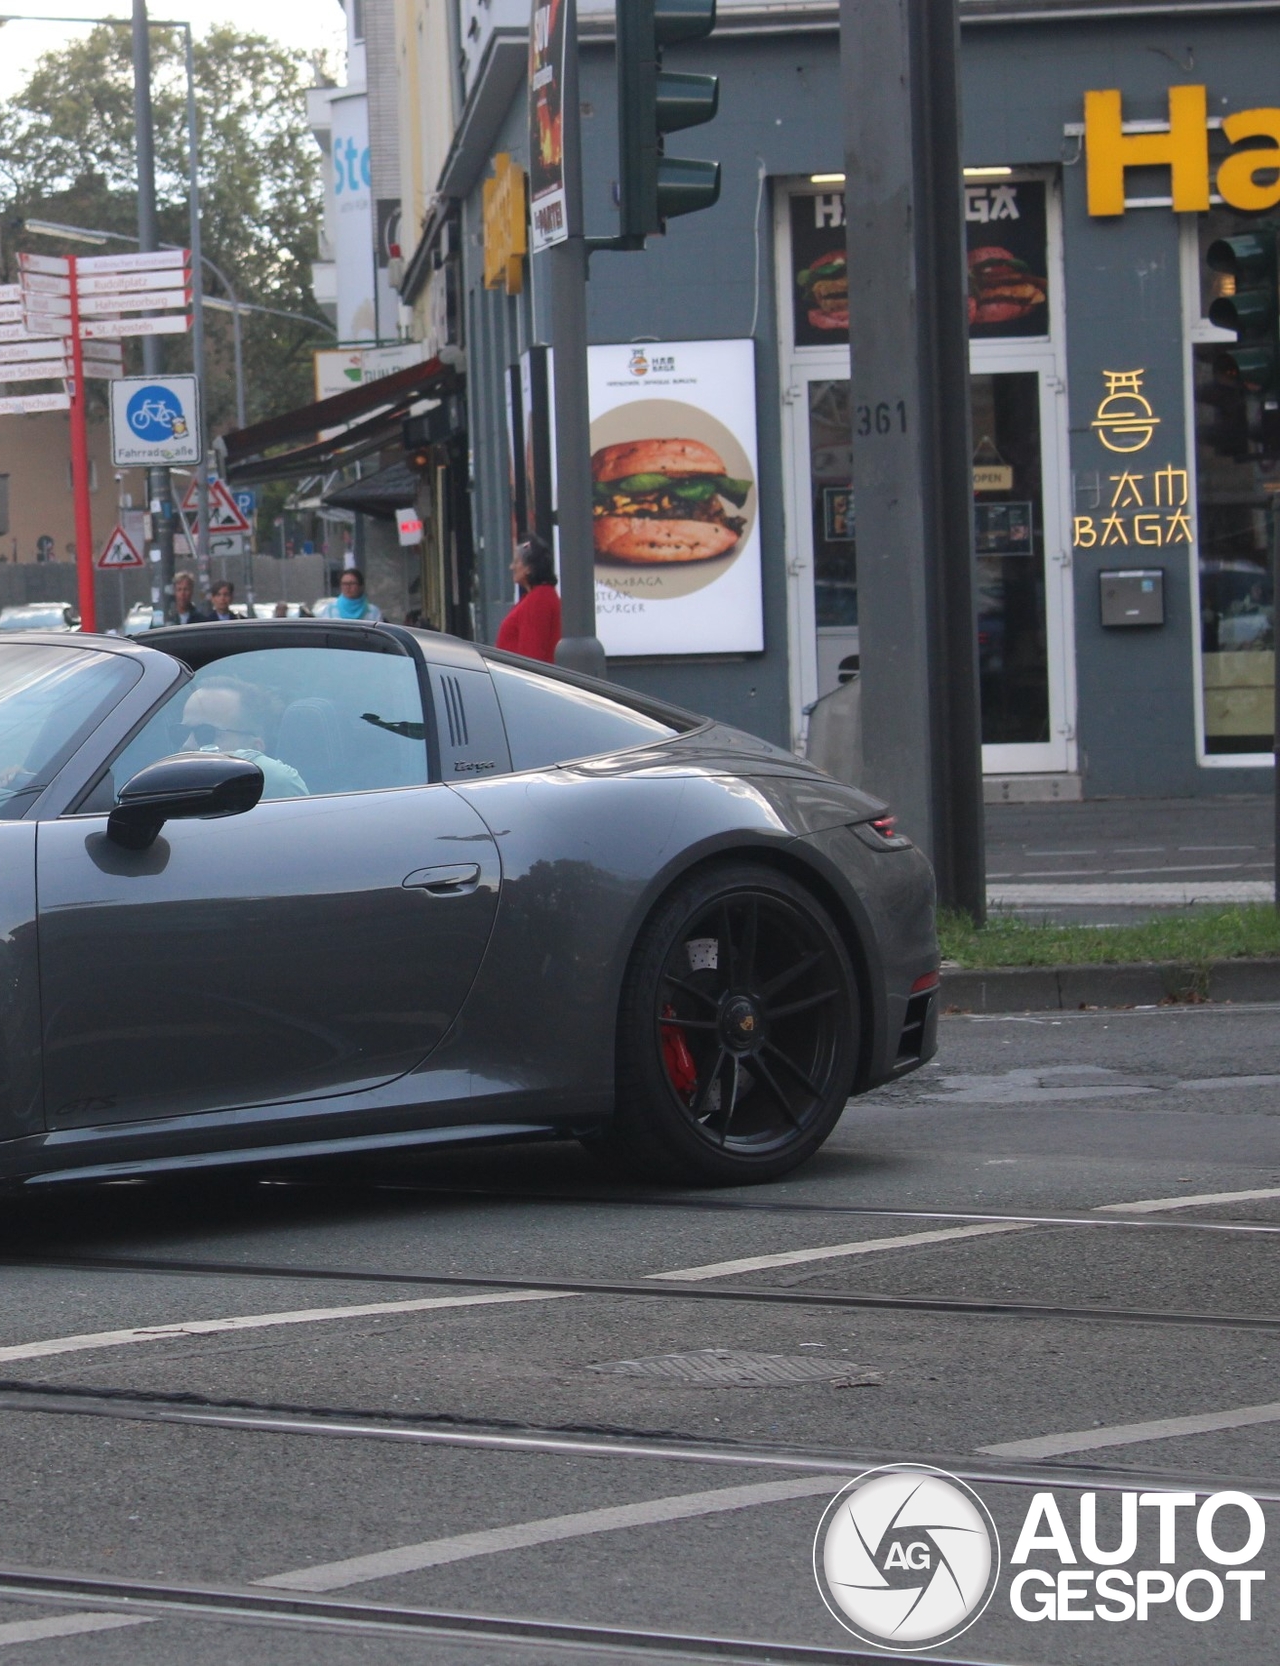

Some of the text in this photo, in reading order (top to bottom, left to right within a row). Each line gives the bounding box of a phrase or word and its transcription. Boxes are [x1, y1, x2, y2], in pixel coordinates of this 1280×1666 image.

[1083, 84, 1280, 217] Ha
[94, 278, 148, 291] Rudolfplatz
[94, 297, 169, 310] Hahnentorburg
[96, 321, 154, 335] St. Aposteln
[856, 400, 908, 437] 361
[118, 445, 194, 459] Fahrradsaße
[973, 472, 1002, 484] OPEN
[1072, 463, 1189, 510] HAM
[1072, 507, 1194, 548] BAGA
[596, 603, 646, 615] BURGER
[453, 759, 495, 774] Targa
